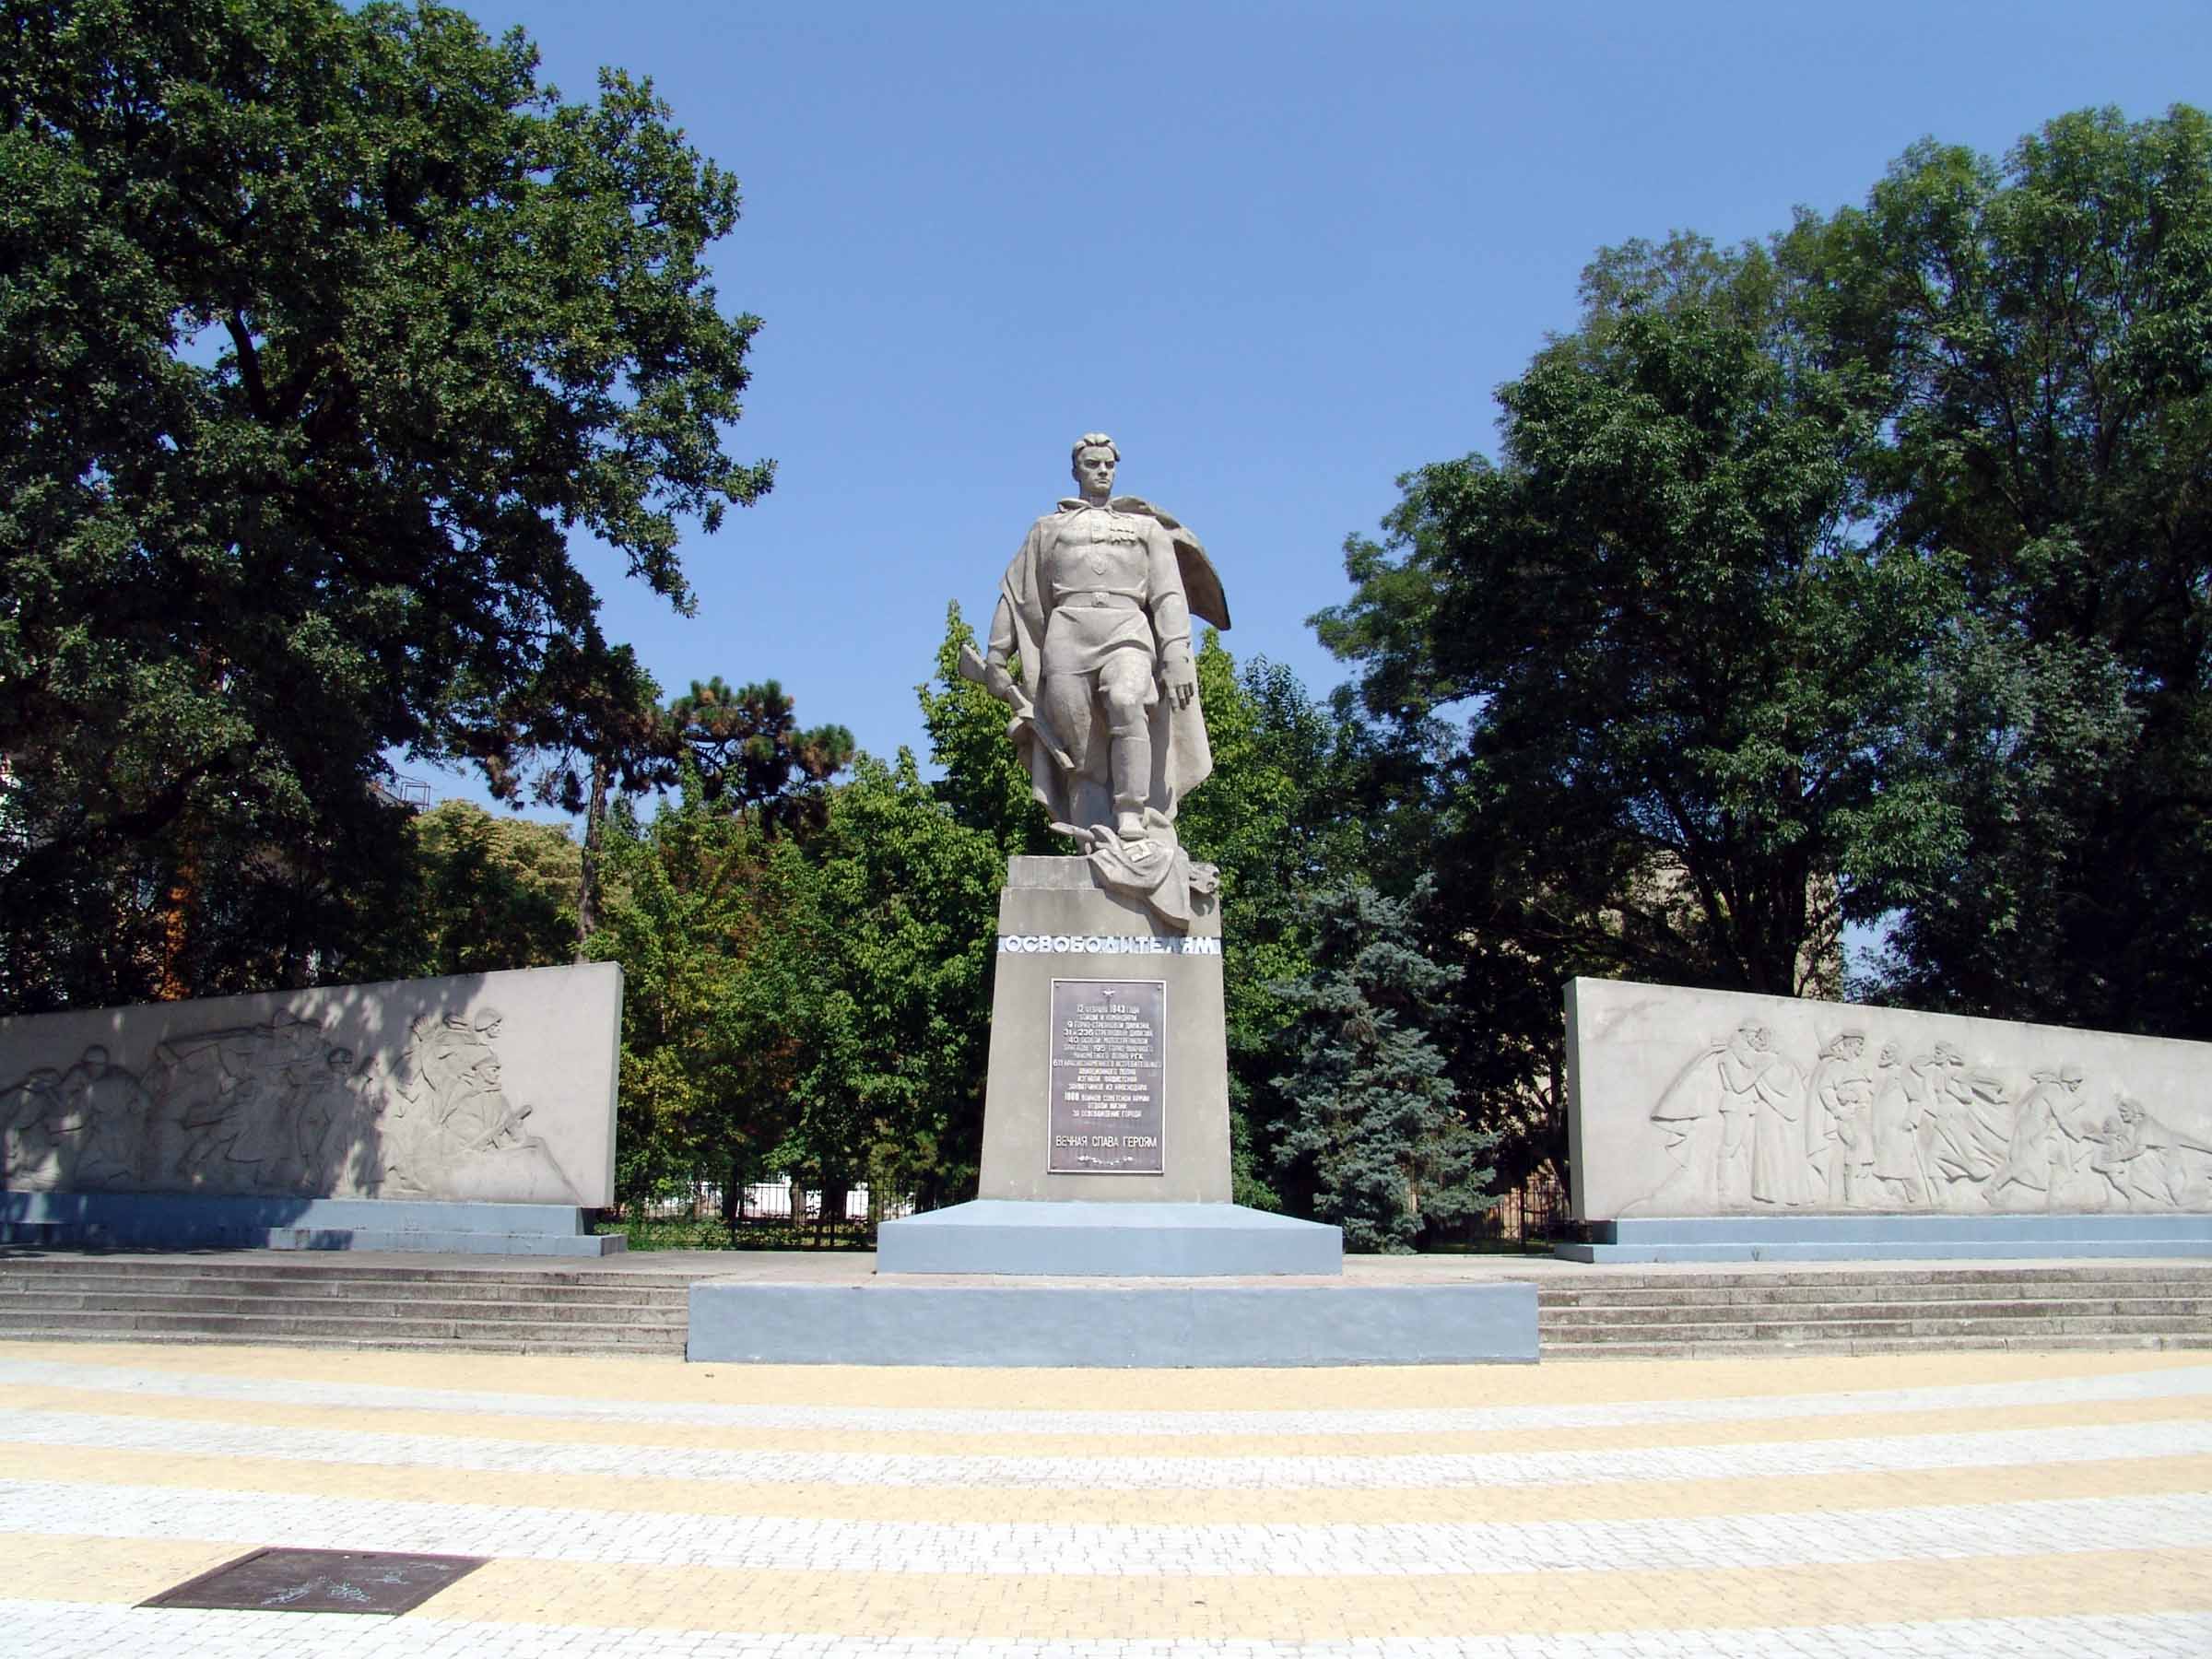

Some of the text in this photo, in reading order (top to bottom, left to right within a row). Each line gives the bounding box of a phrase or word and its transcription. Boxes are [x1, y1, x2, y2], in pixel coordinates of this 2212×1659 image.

[1055, 1135, 1158, 1147] ВЕЧНАЯ СЛАВА ГЕРОЯМ
